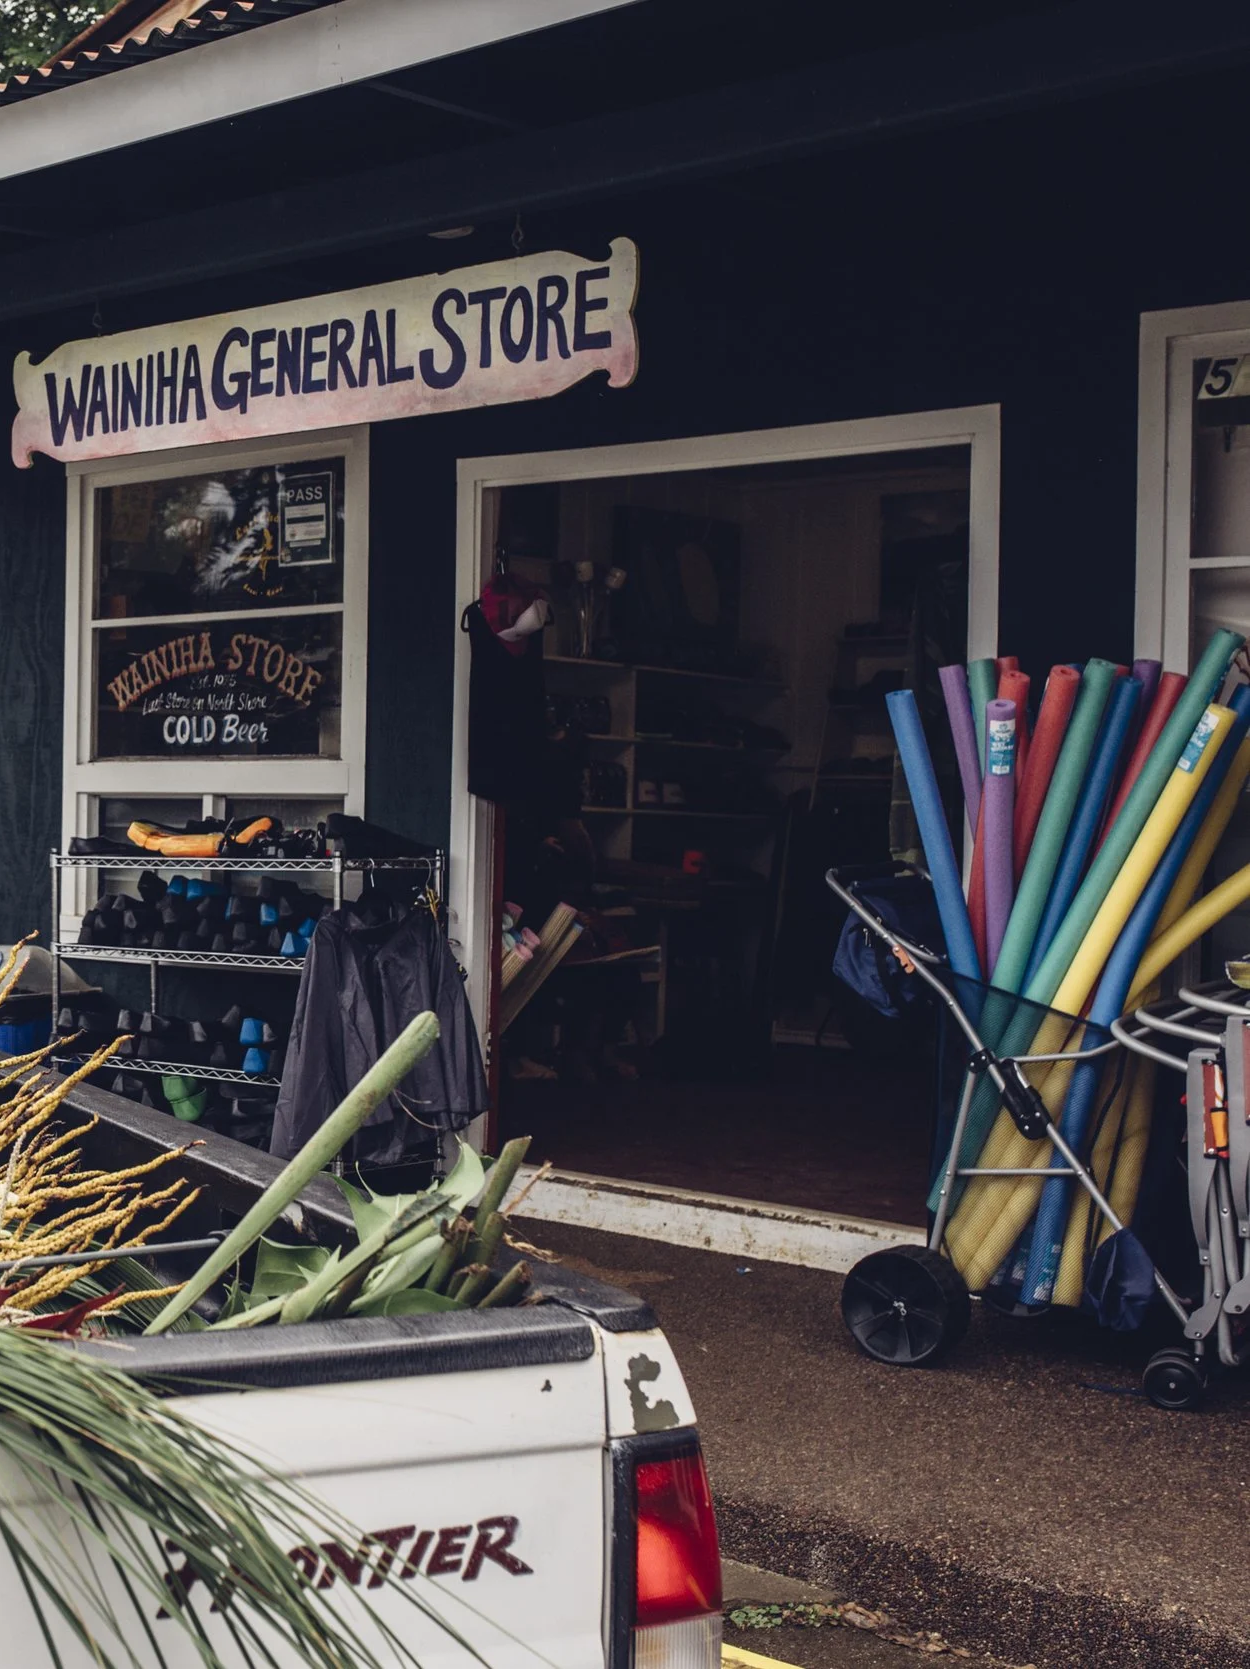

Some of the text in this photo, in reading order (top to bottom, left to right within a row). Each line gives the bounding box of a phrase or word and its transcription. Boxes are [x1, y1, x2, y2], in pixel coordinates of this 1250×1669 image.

[44, 265, 613, 447] WAINIHA GENERAL STORE
[286, 486, 324, 503] PASS
[106, 632, 323, 712] WAINIHA STORE
[163, 713, 270, 745] COLD Beer
[237, 692, 268, 711] Shore
[156, 1515, 535, 1620] FONTIER
